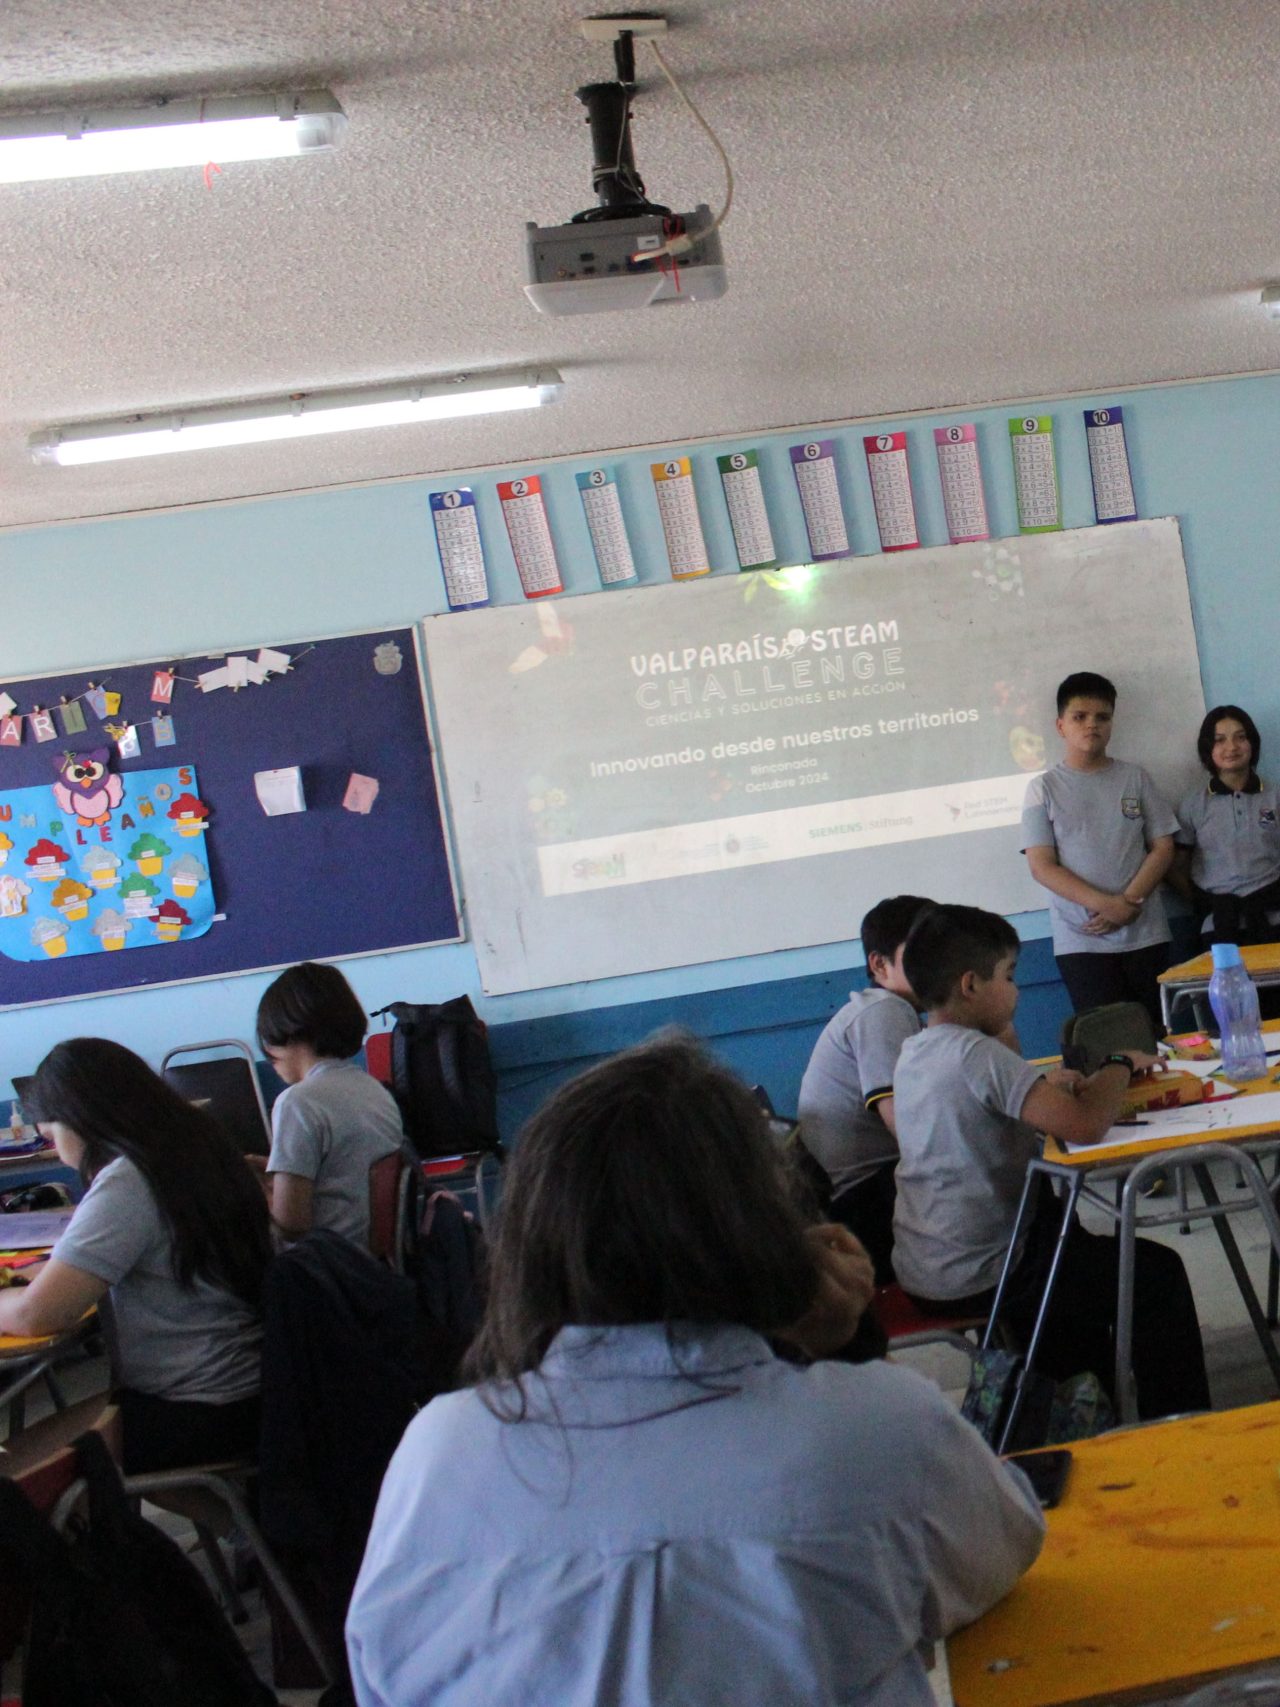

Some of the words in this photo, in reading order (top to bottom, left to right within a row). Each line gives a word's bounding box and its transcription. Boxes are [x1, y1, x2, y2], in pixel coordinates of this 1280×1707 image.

[1095, 411, 1108, 423] 10
[1026, 420, 1034, 431] 9
[950, 428, 959, 440] 8
[880, 437, 888, 449] 7
[807, 444, 816, 456] 6
[733, 455, 743, 468] 5
[667, 463, 676, 475] 4
[593, 471, 602, 483] 3
[514, 482, 525, 494] 2
[447, 494, 455, 506] 1
[811, 620, 899, 652] STEAM
[636, 647, 905, 710] CHALLENGE
[646, 707, 712, 728] CIENCIAS
[718, 706, 726, 716] Y
[731, 693, 822, 716] SOLUCIONES
[828, 689, 847, 702] EN
[590, 747, 706, 777] Innovando
[711, 736, 776, 759] desde
[782, 721, 873, 748] nuestros
[877, 708, 980, 736] territorios
[750, 756, 818, 776] Rinconada
[745, 774, 797, 793] Octubre
[799, 771, 830, 786] 2024
[808, 822, 863, 839] SIEMENS
